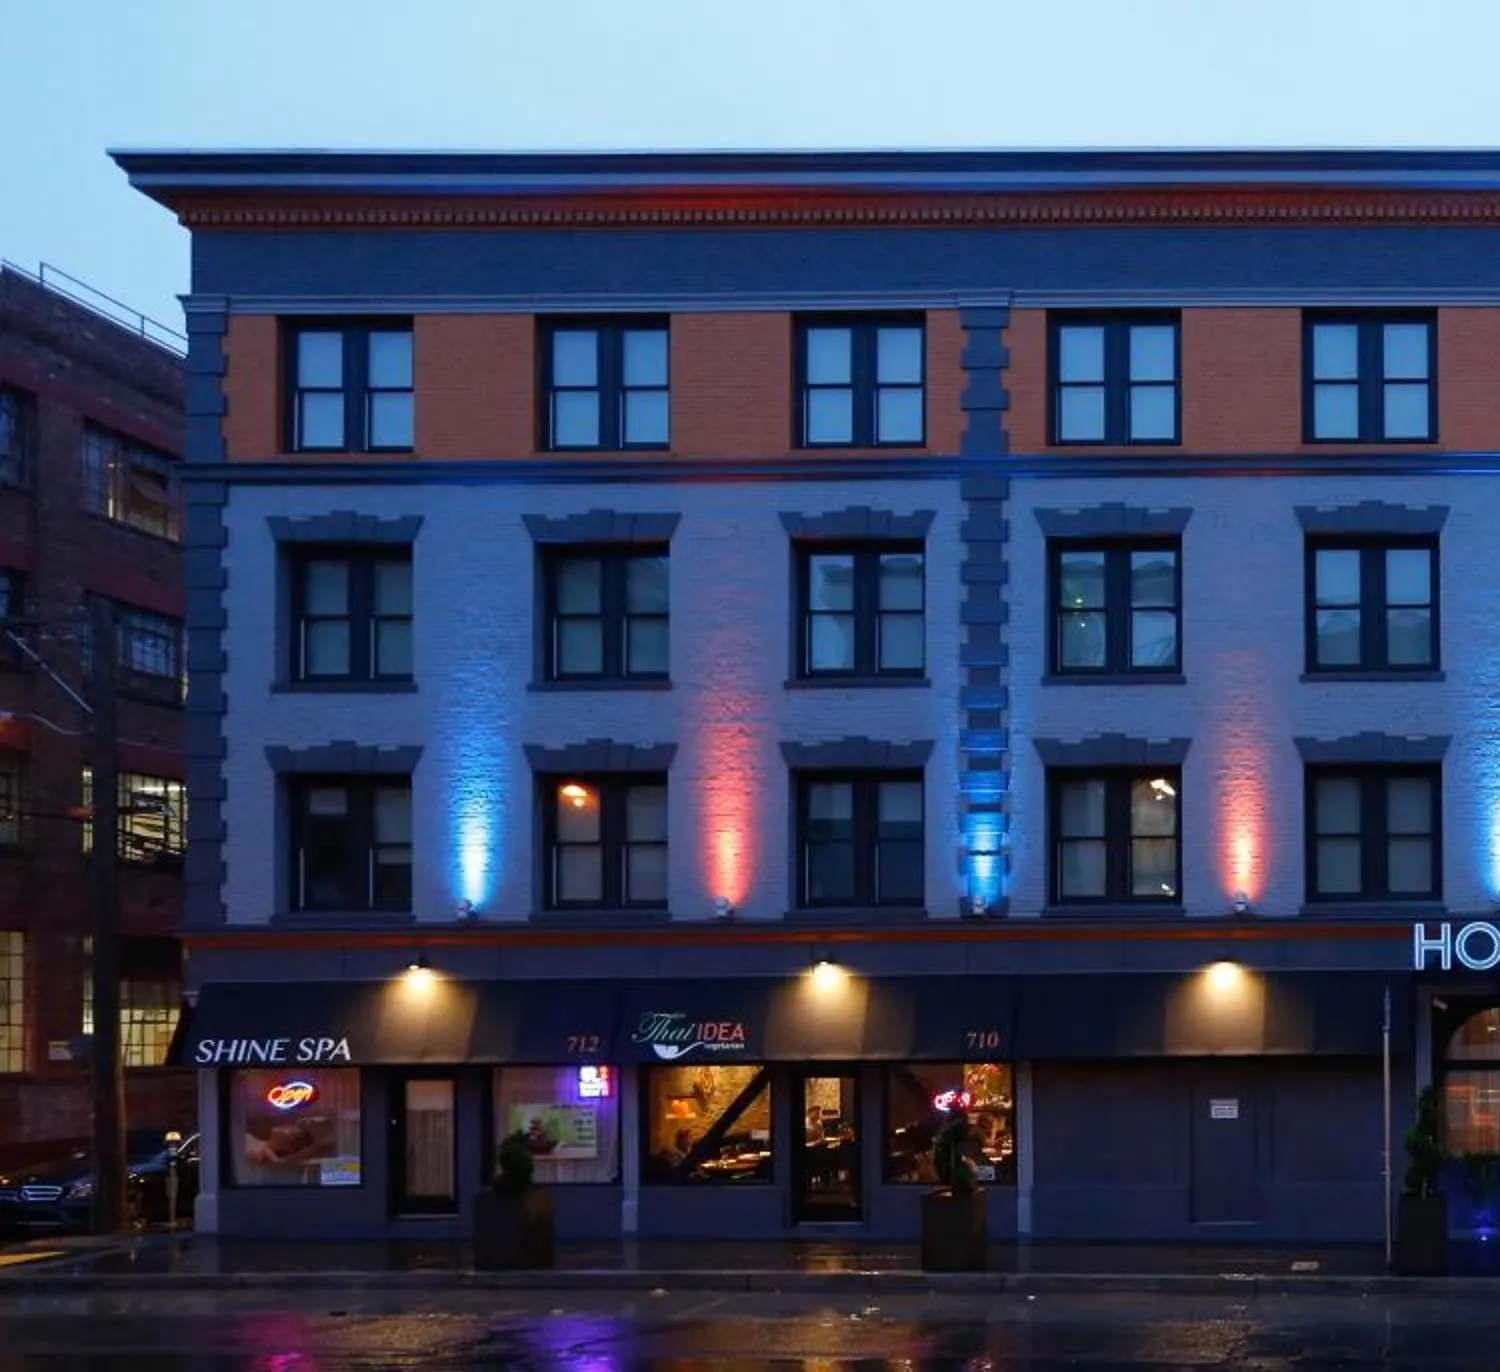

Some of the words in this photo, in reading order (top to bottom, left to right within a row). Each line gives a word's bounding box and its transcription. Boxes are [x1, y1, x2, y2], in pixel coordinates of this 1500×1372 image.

[632, 1012, 696, 1042] Thai
[697, 1023, 745, 1041] IDEA
[195, 1038, 290, 1063] SHINE
[296, 1037, 352, 1062] SPA
[567, 1036, 599, 1053] 712
[967, 1032, 999, 1049] 710
